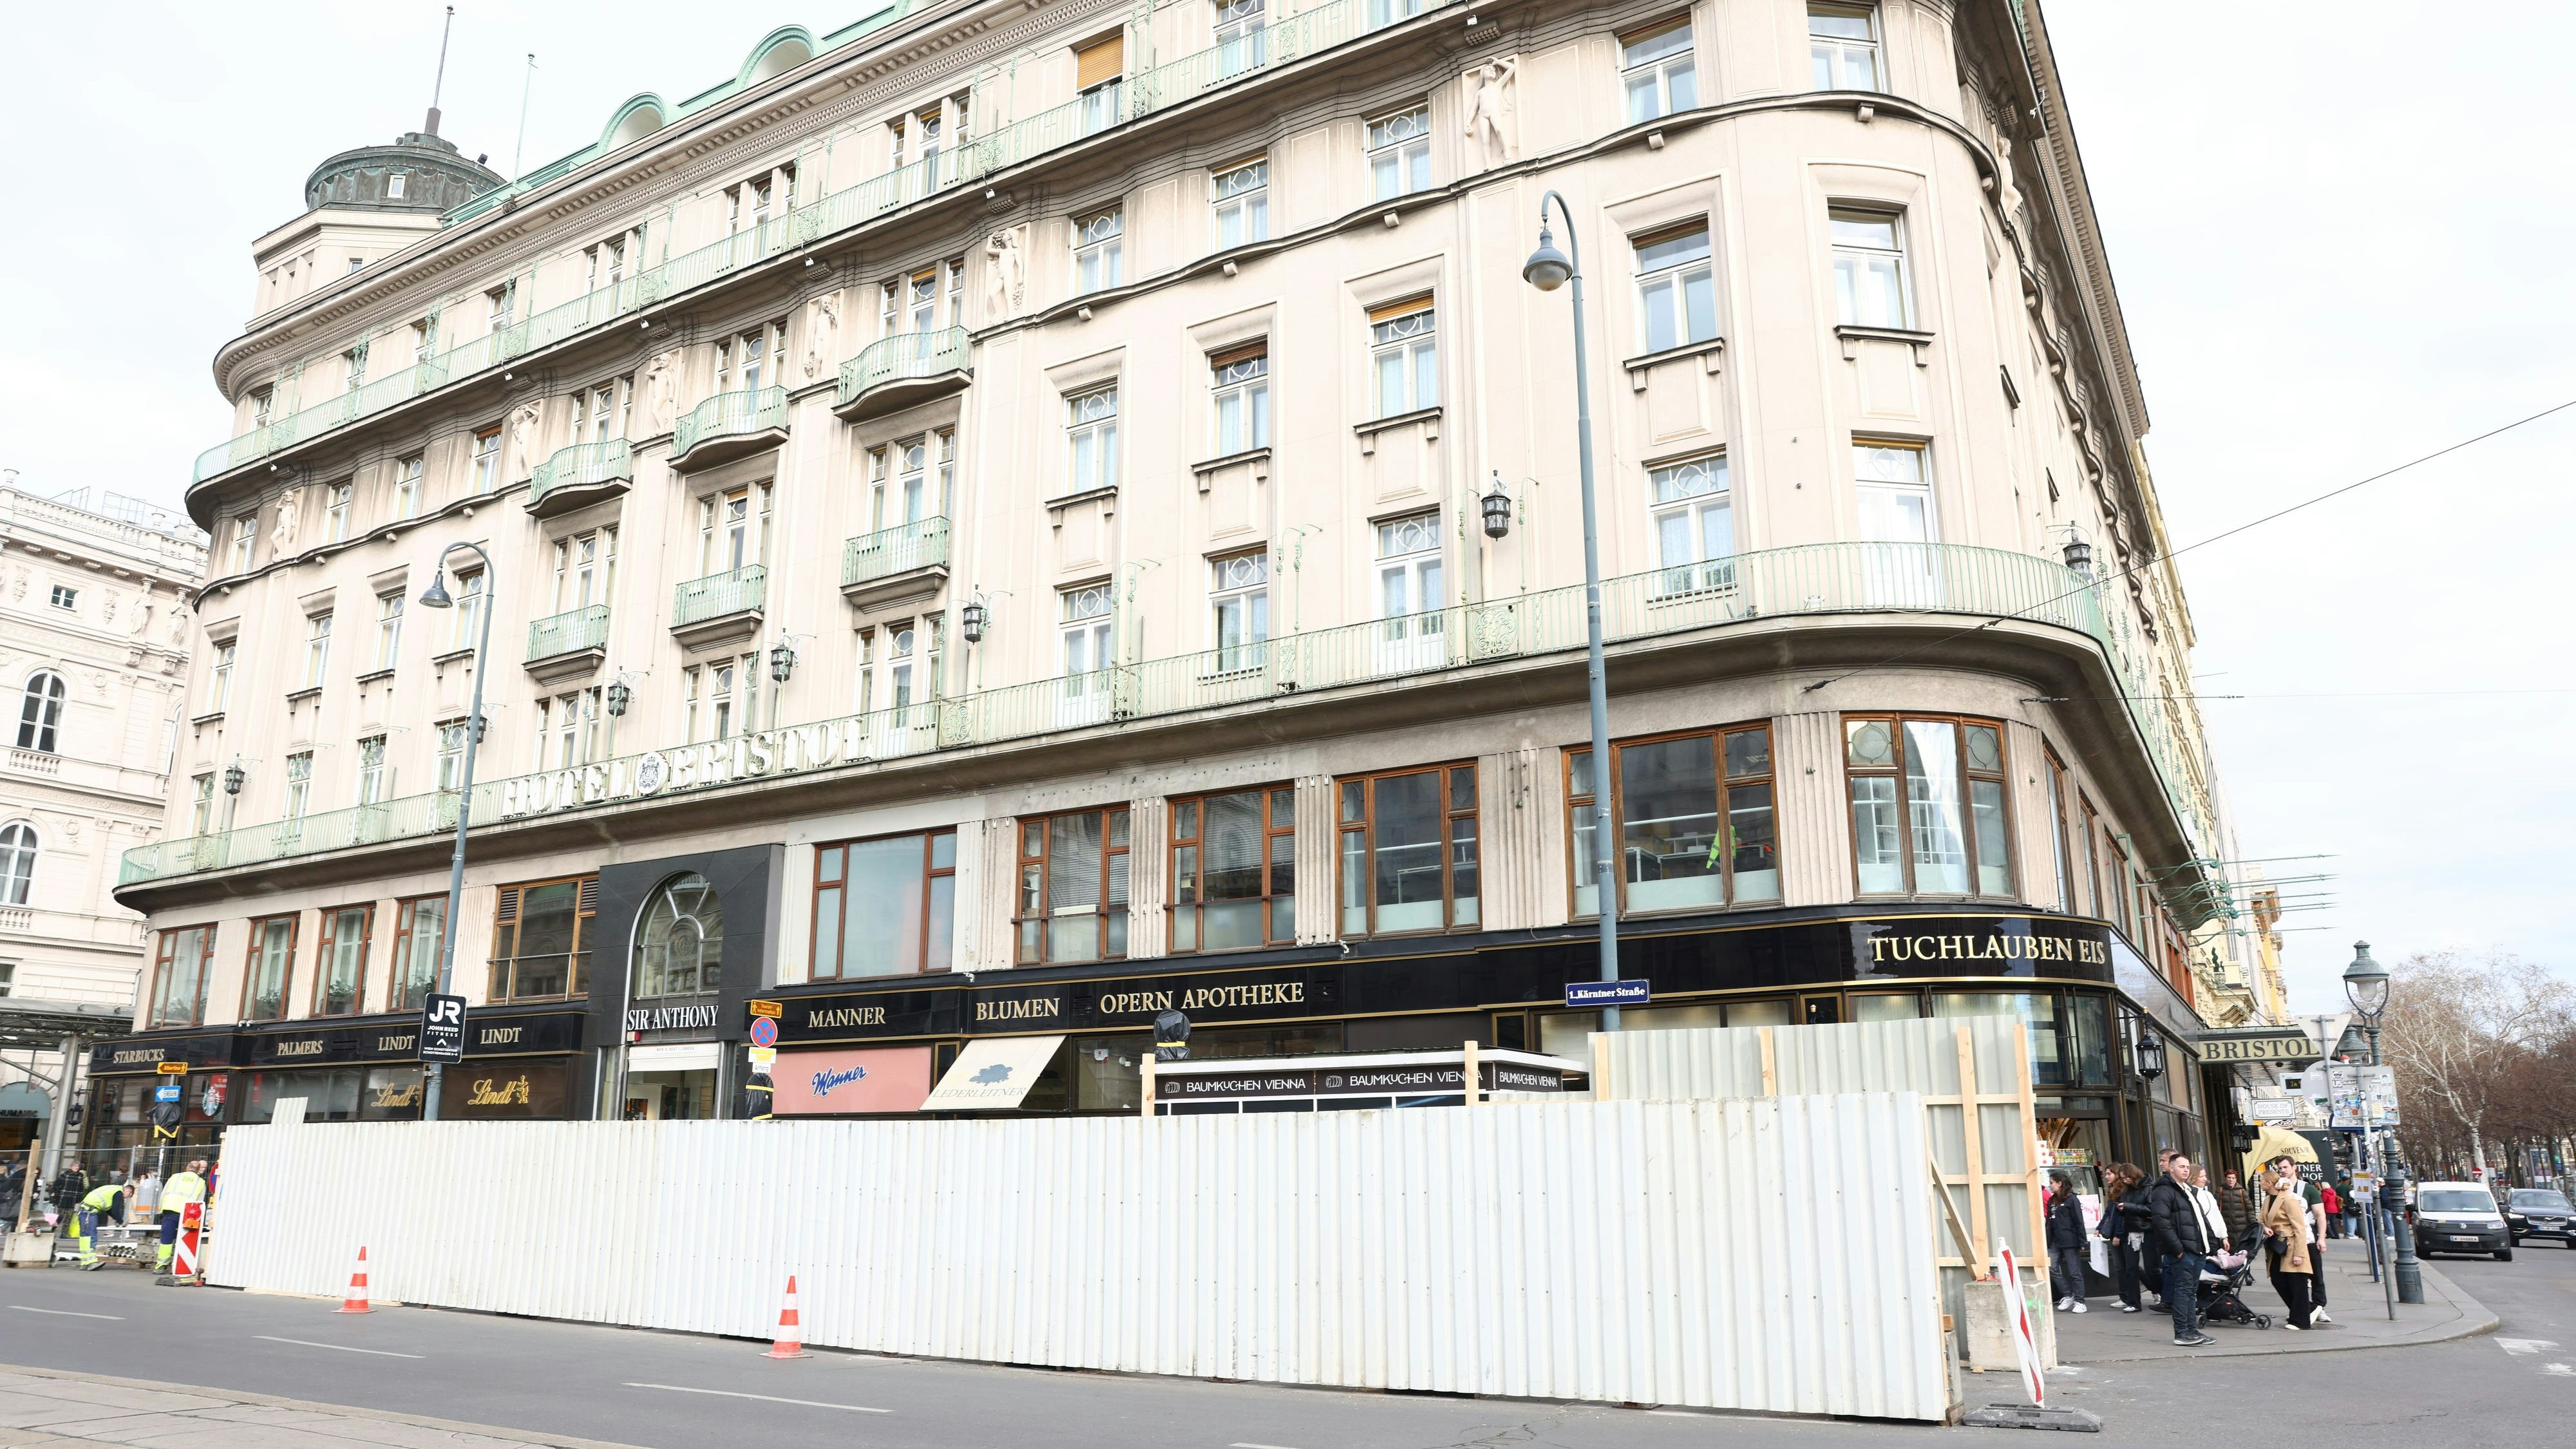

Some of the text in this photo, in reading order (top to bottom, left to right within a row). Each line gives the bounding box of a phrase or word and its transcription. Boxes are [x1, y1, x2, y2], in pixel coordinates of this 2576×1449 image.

[500, 717, 873, 820] HOTEL BRISTOL
[1868, 934, 2106, 965] TUCHLAUBEN EIS
[1100, 982, 1305, 1014] OPERN APOTHEKE
[1616, 987, 1645, 996] Straße
[429, 1000, 460, 1024] JR
[627, 1005, 719, 1030] SIR ANTHONY
[808, 1007, 886, 1028] MANNER
[975, 998, 1060, 1021] BLUMEN
[378, 1035, 415, 1051] LINDT
[480, 1027, 522, 1045] LINDT
[113, 1048, 165, 1063] STARBUCKS
[277, 1041, 323, 1056] PALMERS
[2204, 1039, 2320, 1059] BRISTOL
[811, 1066, 869, 1097] Manner
[1264, 1078, 1306, 1090] VIENNA
[1436, 1071, 1483, 1083] VIENA
[1538, 1075, 1557, 1088] VIENNA
[371, 1083, 417, 1107] Lindt
[468, 1079, 517, 1105] Lindt
[933, 1087, 1027, 1097] LEDERLEITNER
